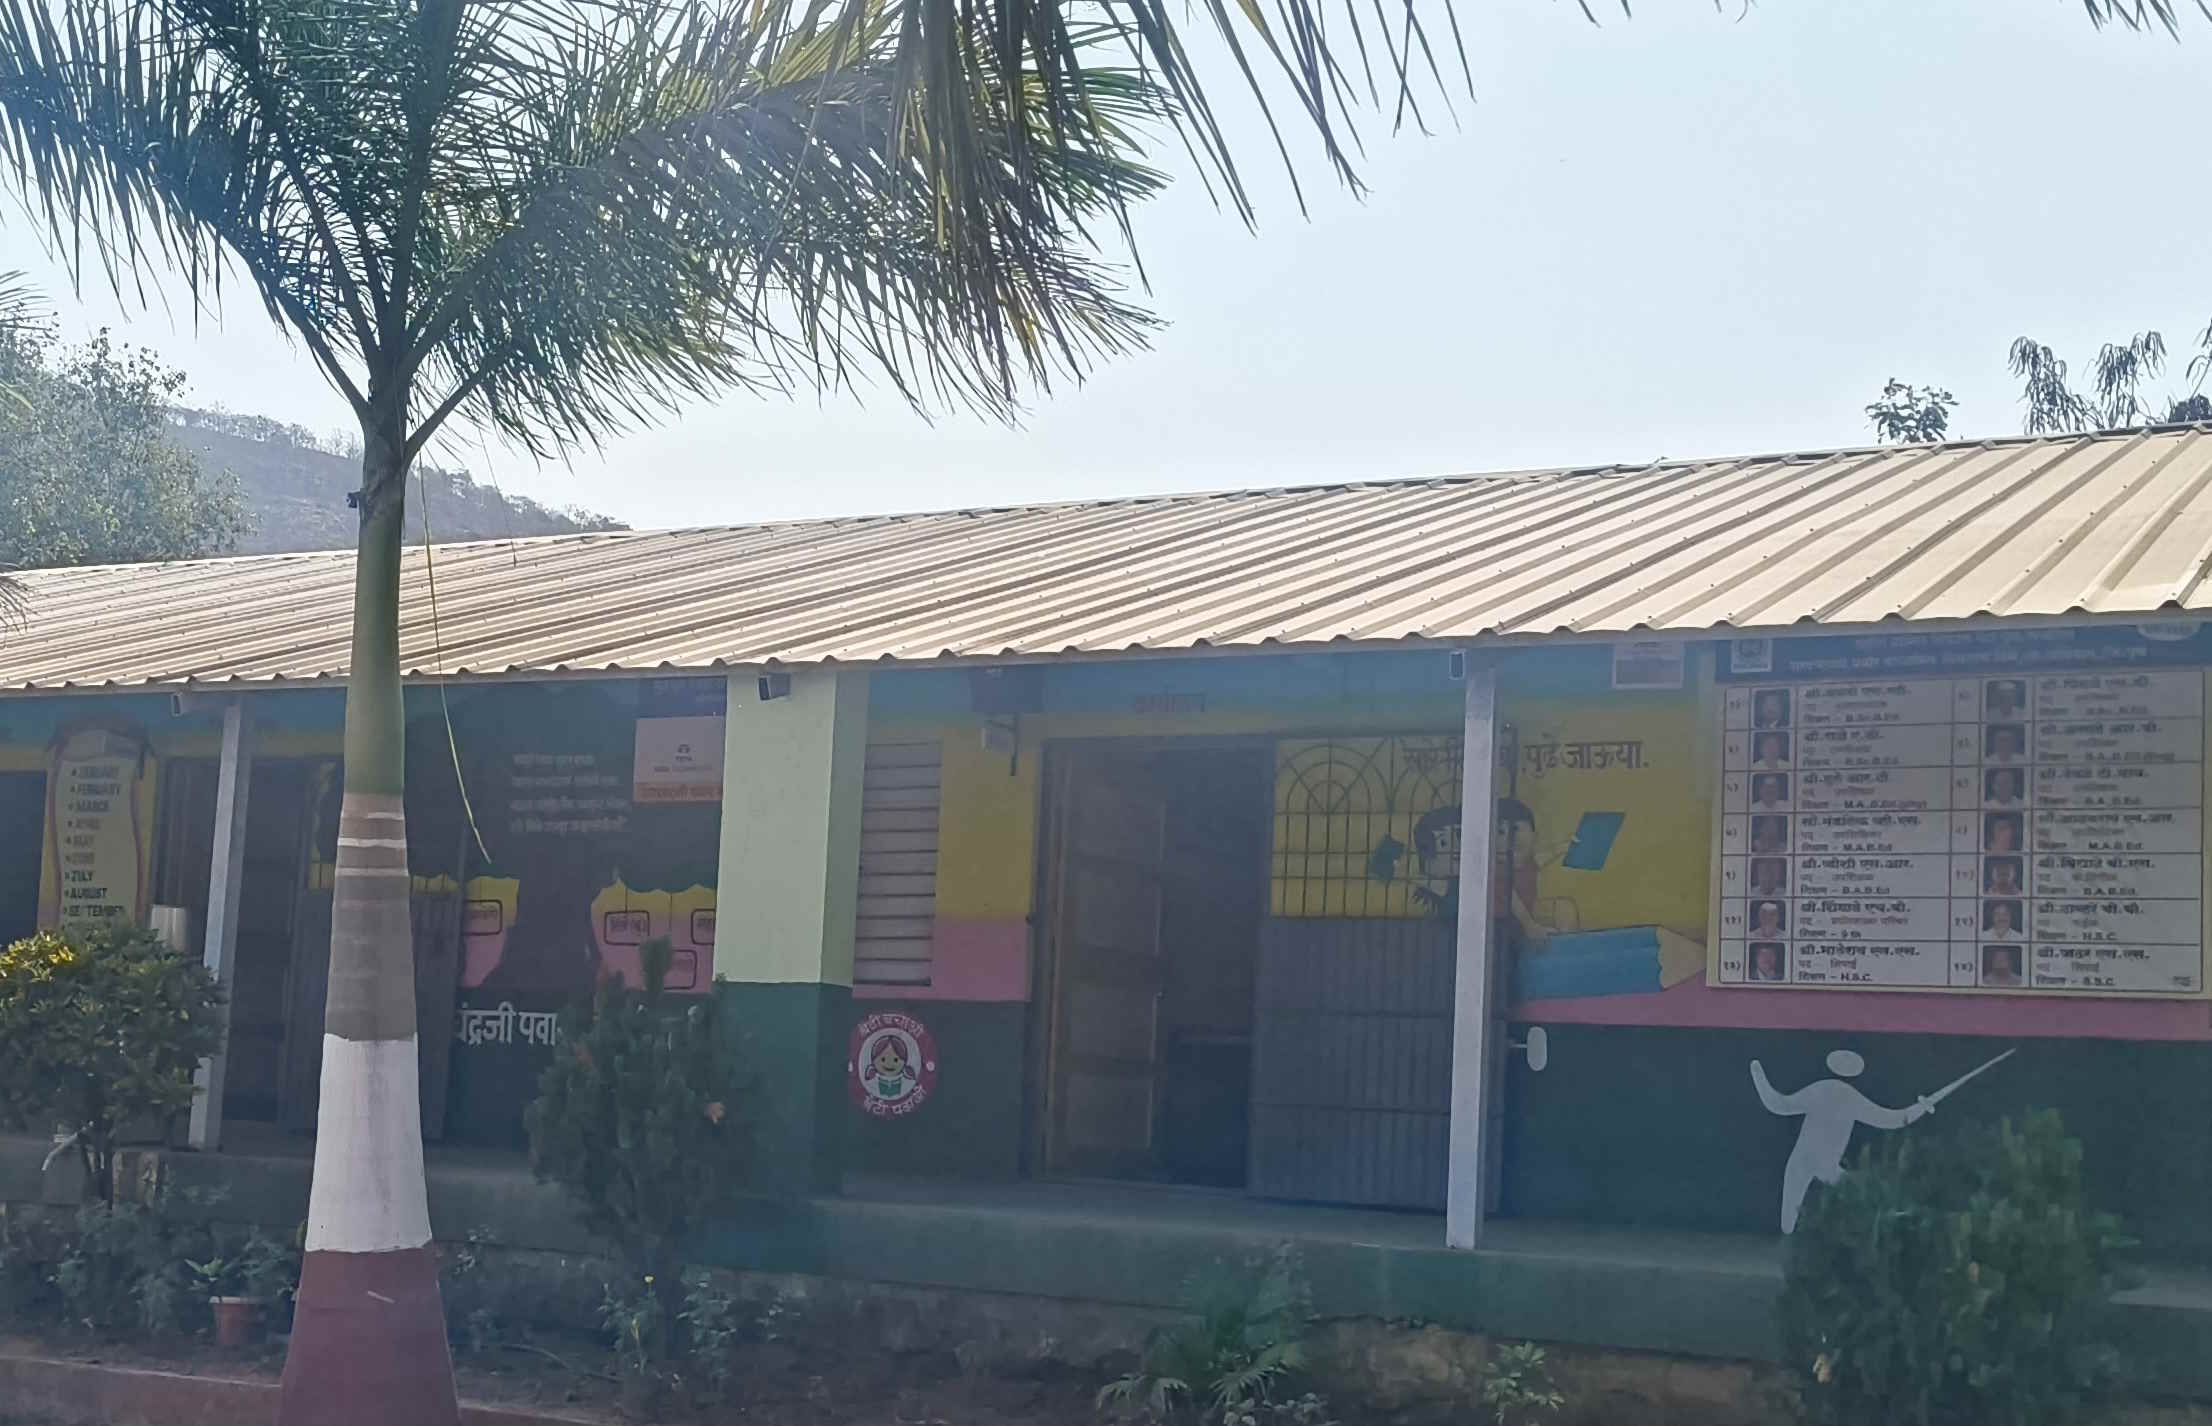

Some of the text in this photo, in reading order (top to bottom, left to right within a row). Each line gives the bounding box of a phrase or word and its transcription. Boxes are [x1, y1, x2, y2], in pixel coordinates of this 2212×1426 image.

[71, 870, 94, 882] JULY
[70, 887, 108, 899] AUGUST
[519, 1009, 564, 1047] पवा
